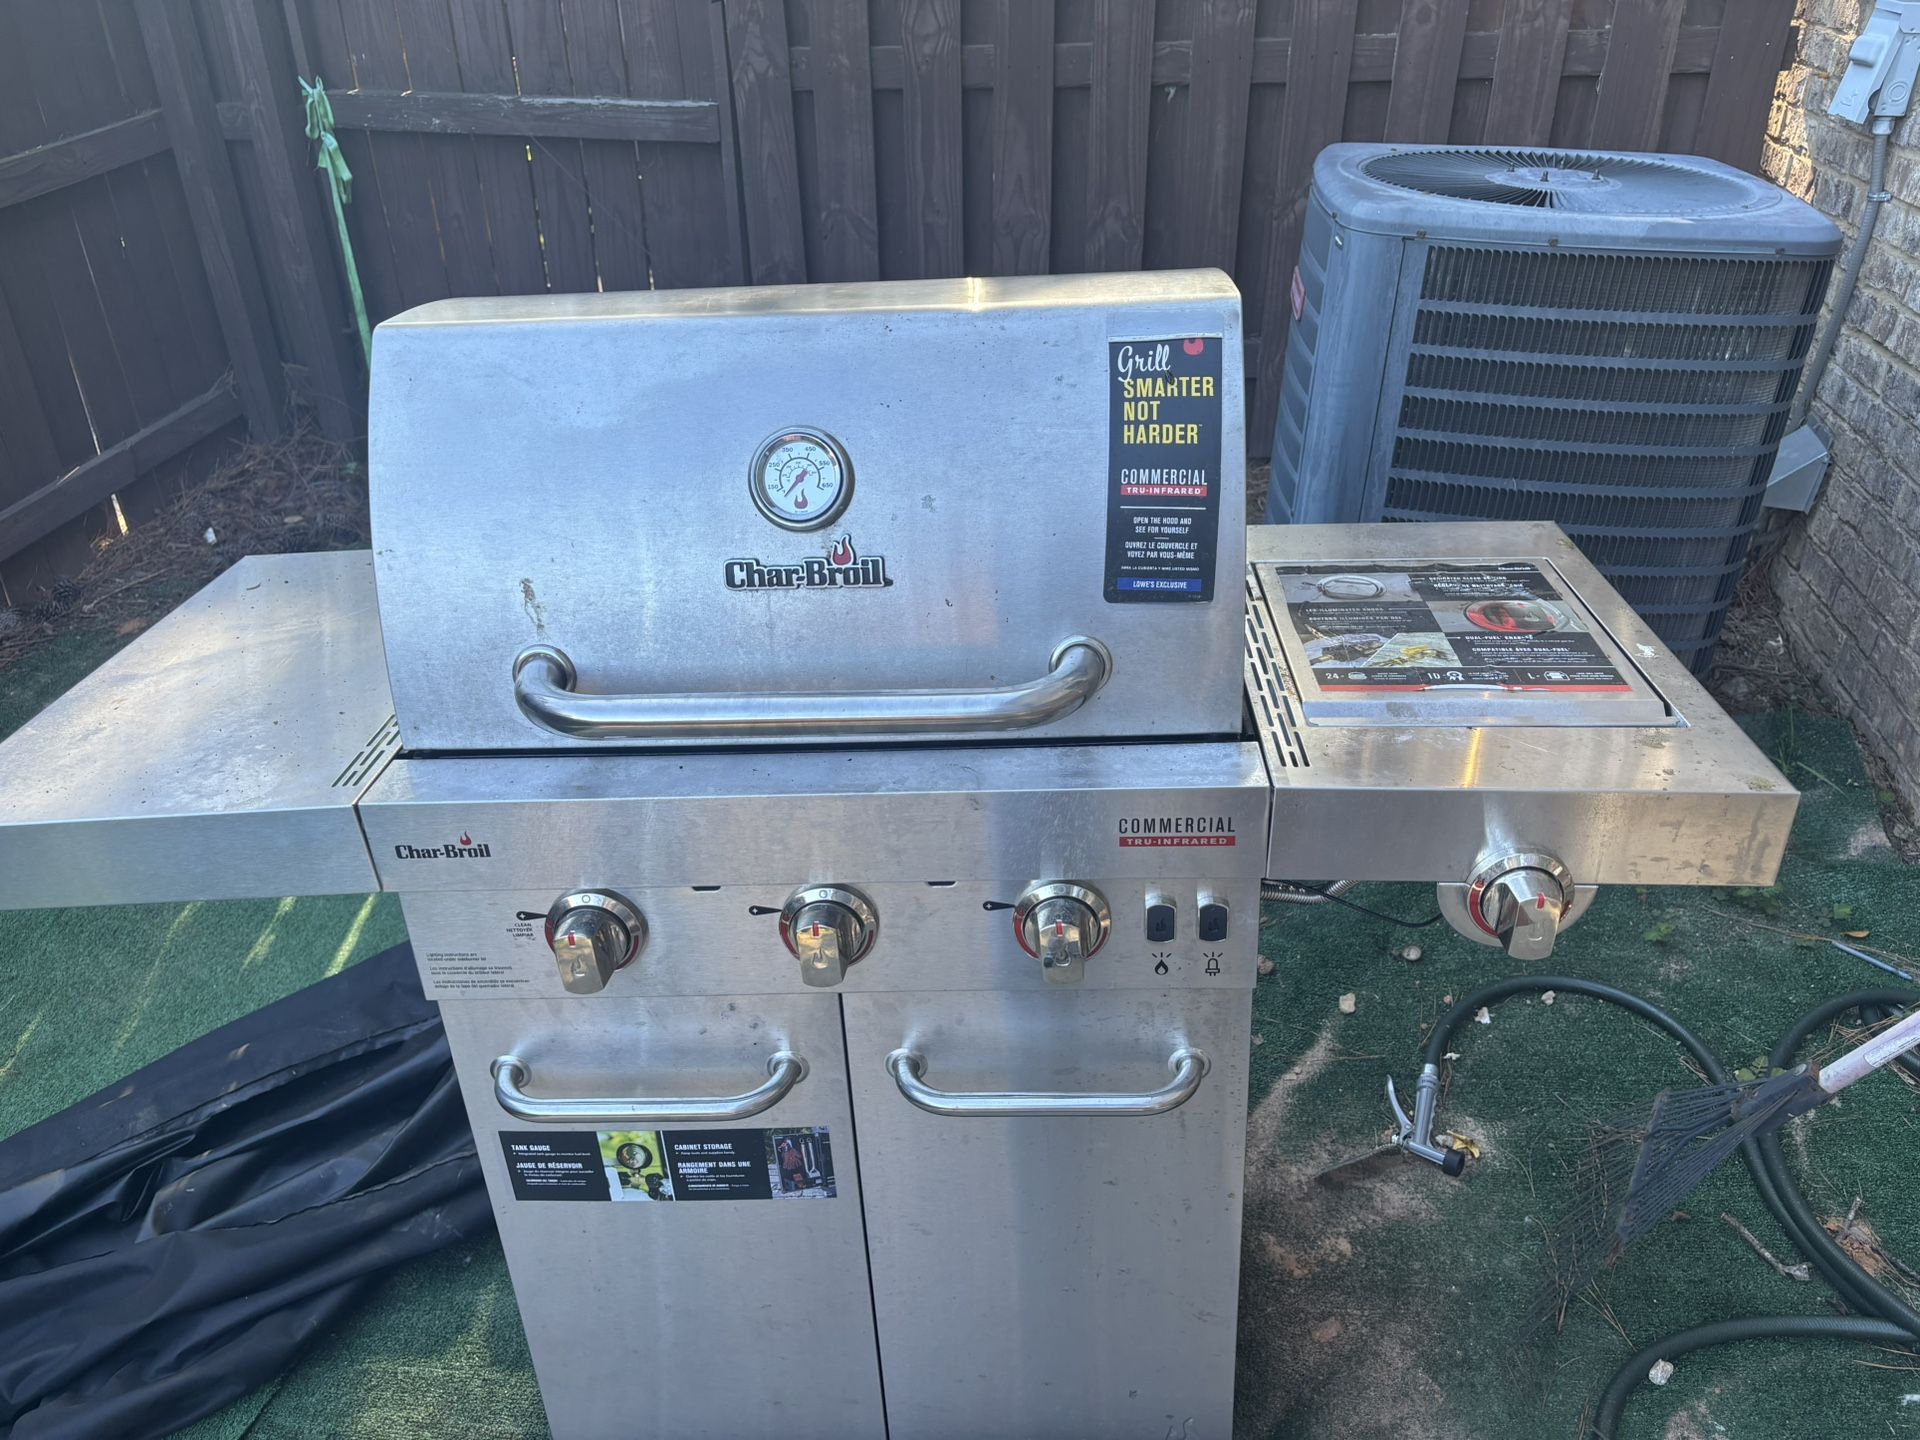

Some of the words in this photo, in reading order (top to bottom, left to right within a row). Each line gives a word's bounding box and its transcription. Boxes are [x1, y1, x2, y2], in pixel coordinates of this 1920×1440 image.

[1117, 343, 1171, 383] Grill
[1123, 376, 1214, 398] SMARTER
[1123, 401, 1160, 421] NOT
[1123, 424, 1198, 444] HARDER
[1121, 468, 1208, 486] COMMERCIAL
[1126, 487, 1201, 495] TRU-INFRARED
[1133, 516, 1149, 524] OPEN
[1162, 517, 1179, 525] HOOD
[1180, 517, 1192, 525] AND
[1147, 526, 1159, 534] FOR
[1160, 526, 1189, 534] YOURSELF
[1124, 541, 1147, 549] OUVREZ
[1148, 541, 1156, 549] LE
[1156, 542, 1189, 550] COUVERCLE
[1190, 542, 1198, 550] ET
[1127, 550, 1145, 558] VOYEZ
[725, 557, 886, 589] Char-Broil
[1132, 580, 1155, 588] LOWE'S
[1156, 581, 1188, 589] EXCLUSIVE
[1119, 817, 1236, 834] COMMERCIAL
[1126, 837, 1227, 846] TRU-INFRARED
[394, 843, 492, 860] Char-Broil
[547, 1161, 583, 1169] RÉSERVOIR
[737, 1160, 751, 1168] UNE
